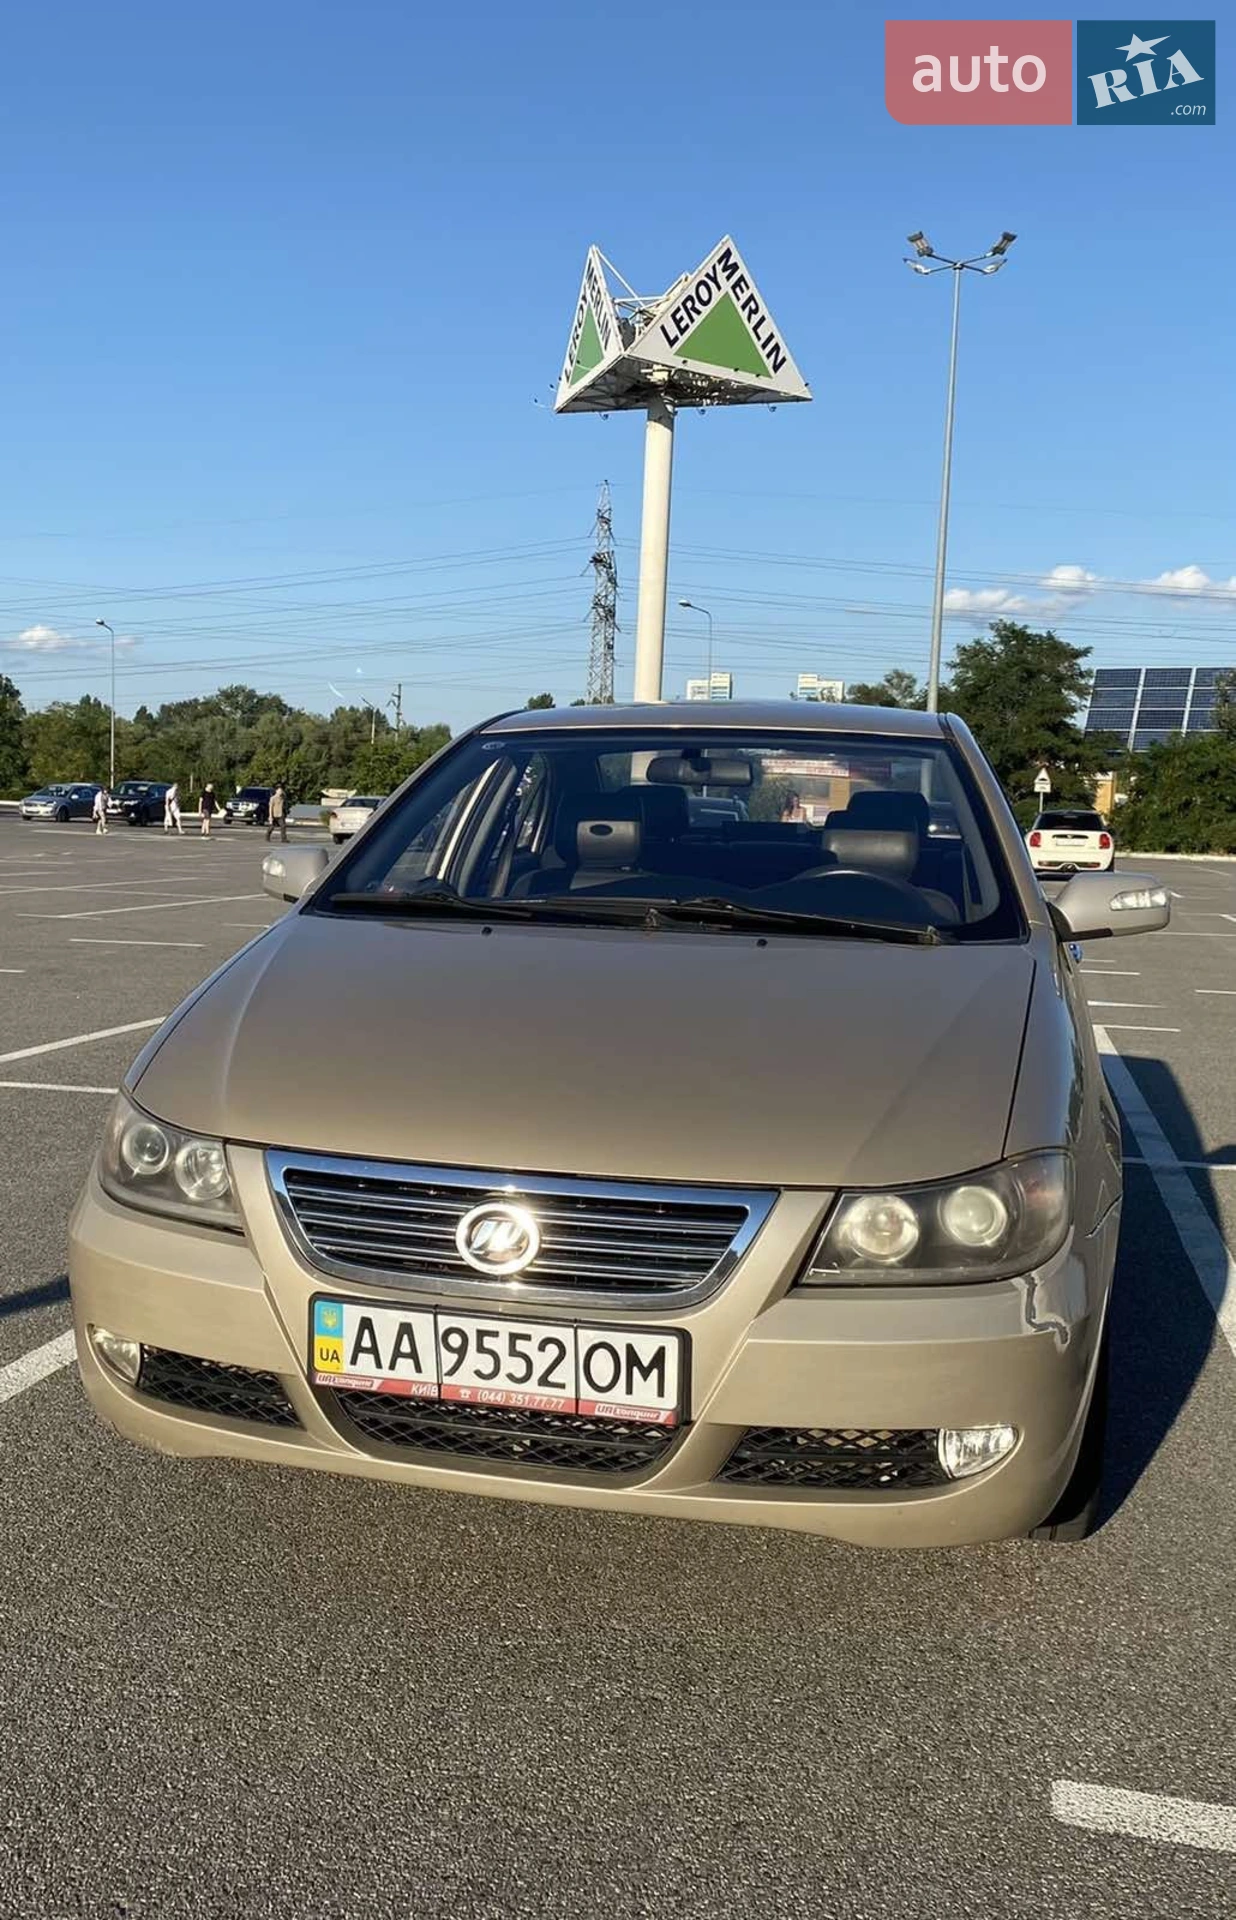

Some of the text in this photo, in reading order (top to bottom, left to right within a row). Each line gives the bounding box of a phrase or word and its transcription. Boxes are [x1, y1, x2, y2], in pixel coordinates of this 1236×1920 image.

[659, 247, 788, 374] LEROY MERLIN
[319, 1347, 341, 1364] UA
[349, 1316, 666, 1399] AA 9552 OM
[477, 1389, 506, 1403] (044)
